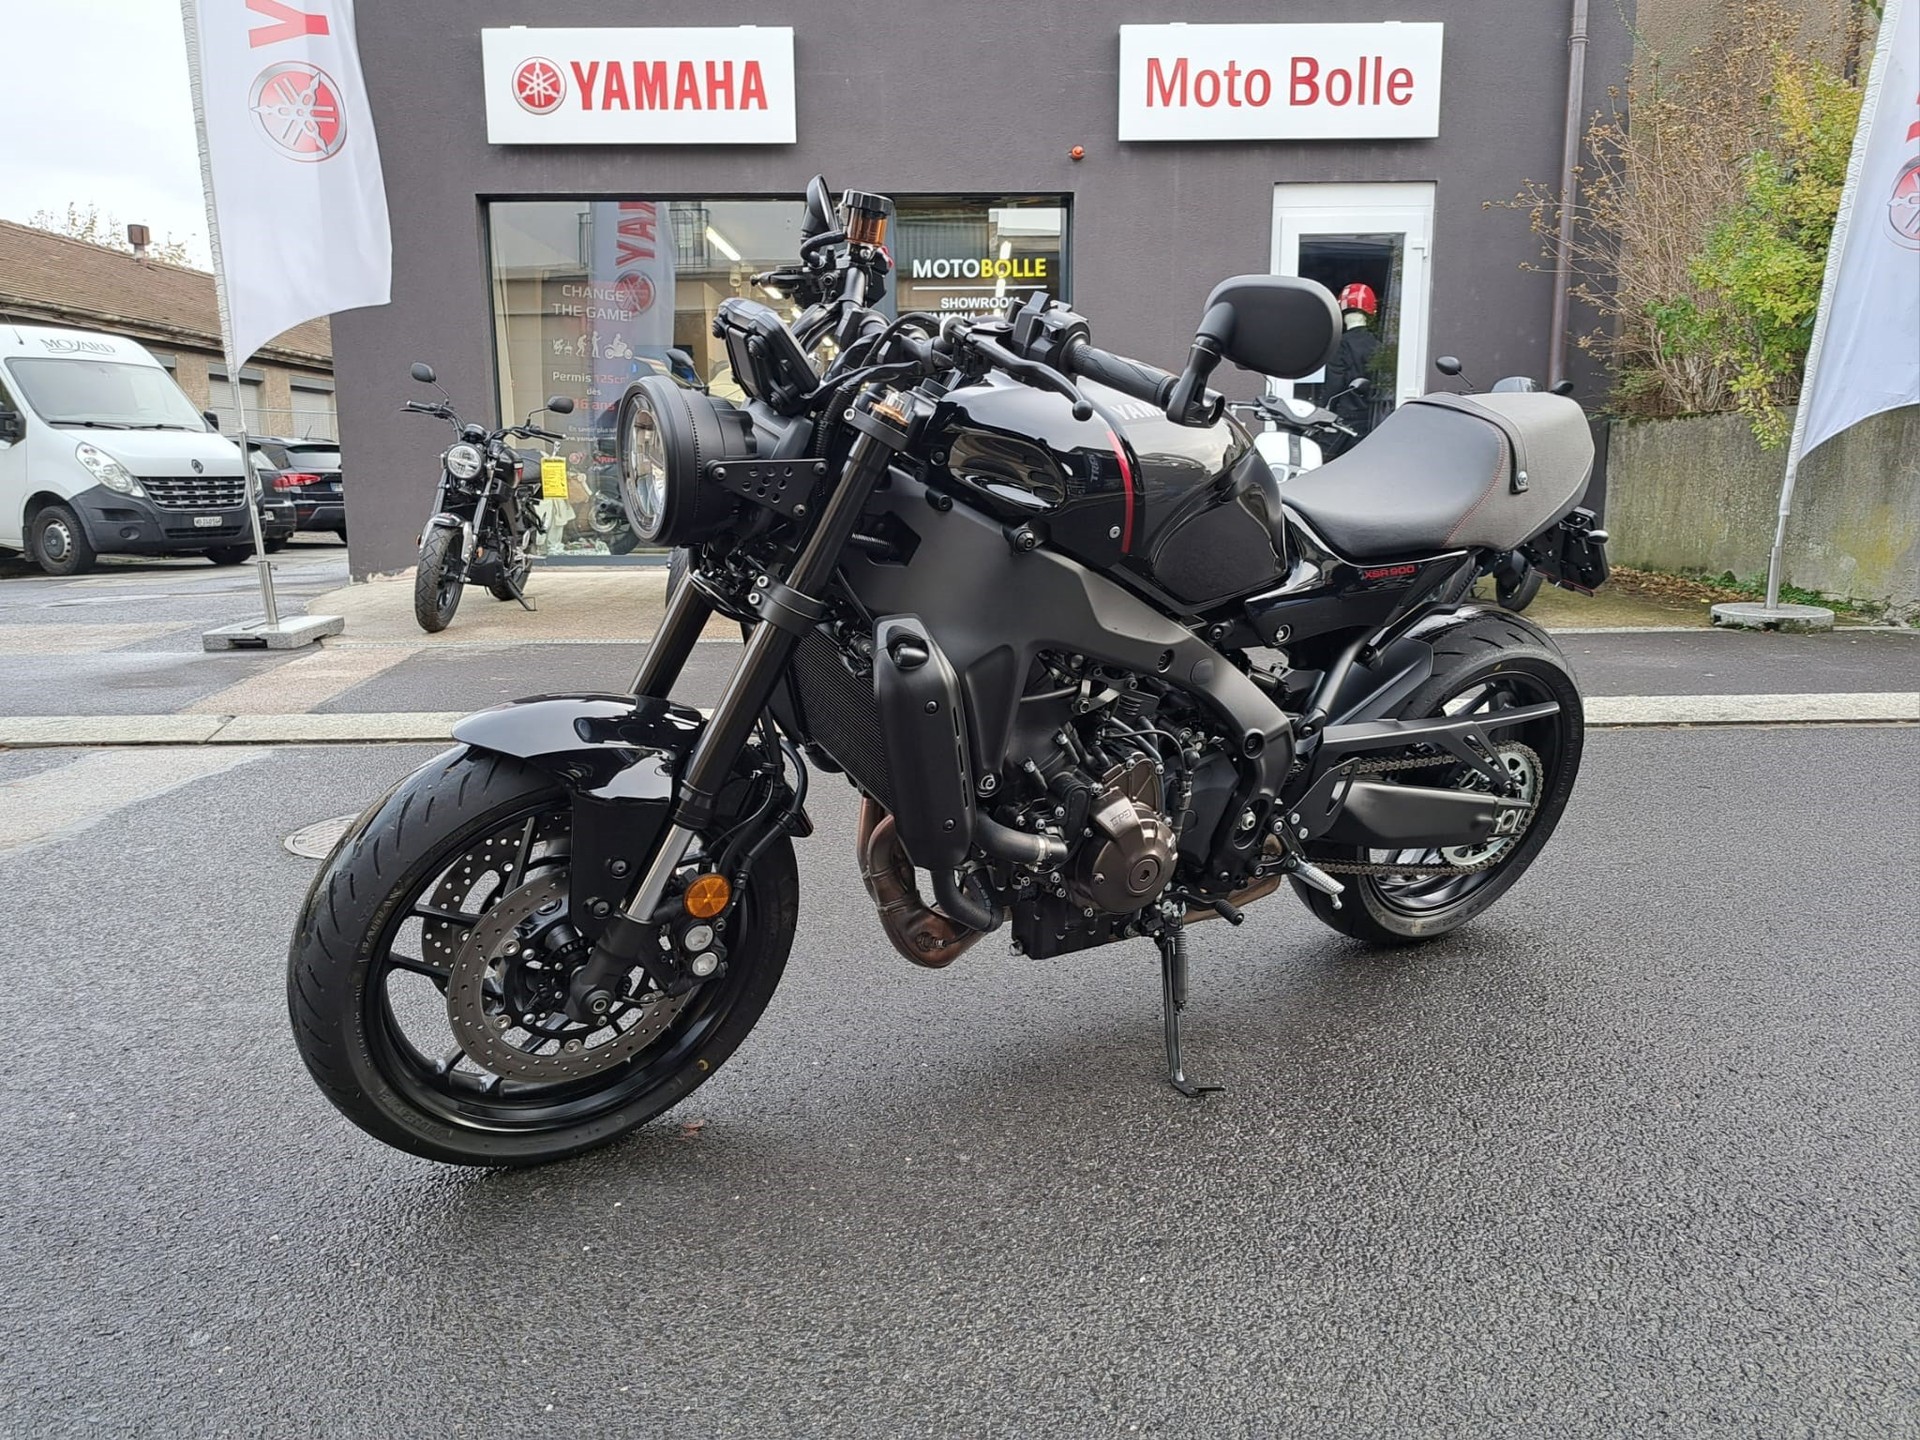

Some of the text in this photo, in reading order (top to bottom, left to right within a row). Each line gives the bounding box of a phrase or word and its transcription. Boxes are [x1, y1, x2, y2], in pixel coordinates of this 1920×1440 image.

[570, 60, 768, 111] YAMAHA
[1146, 56, 1414, 108] Moto Bolle
[912, 257, 1047, 279] MOTOBOLLE
[562, 284, 625, 302] CHANGE
[552, 303, 633, 322] THE GAME!
[40, 339, 117, 356] MOYARD
[552, 371, 592, 383] Permis
[592, 401, 616, 413] ans
